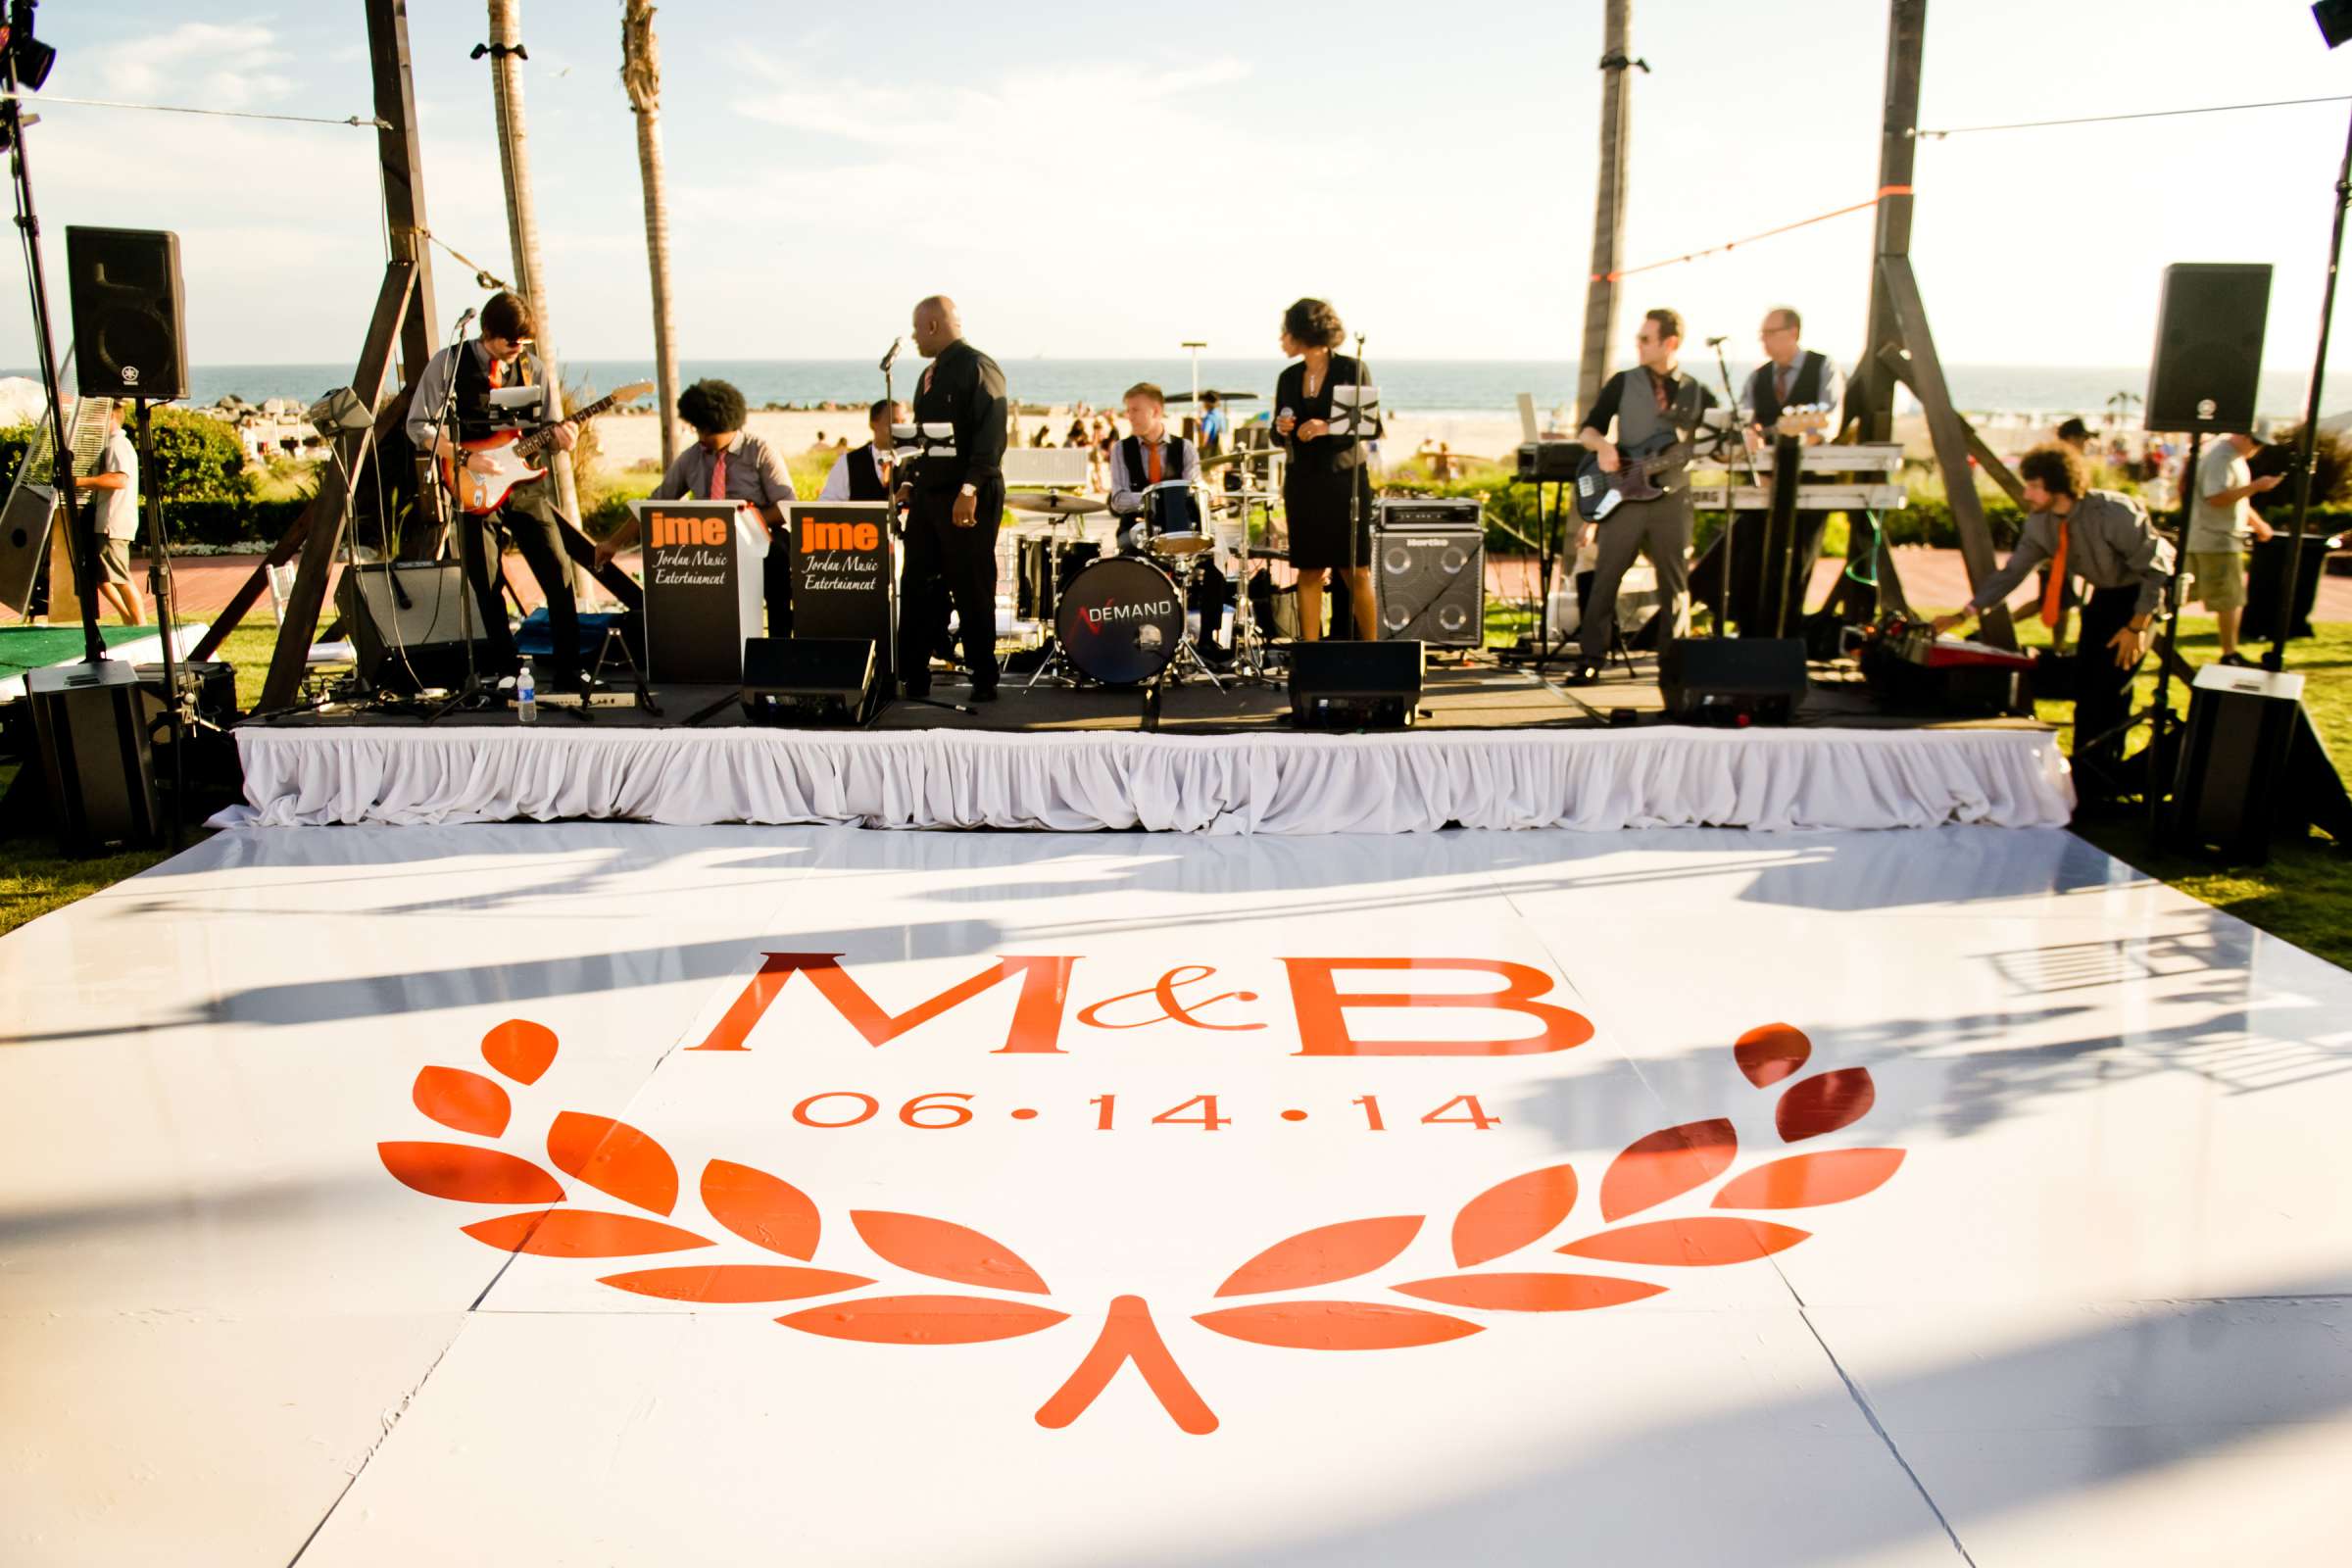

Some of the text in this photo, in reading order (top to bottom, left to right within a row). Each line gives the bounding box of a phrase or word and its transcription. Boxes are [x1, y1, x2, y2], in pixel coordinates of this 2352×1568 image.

[650, 511, 728, 549] jme
[800, 515, 880, 555] jme
[652, 544, 728, 568] Jordan Music
[801, 550, 879, 574] Jordan Music
[655, 567, 727, 585] Entertainment
[804, 573, 877, 591] Entertainment
